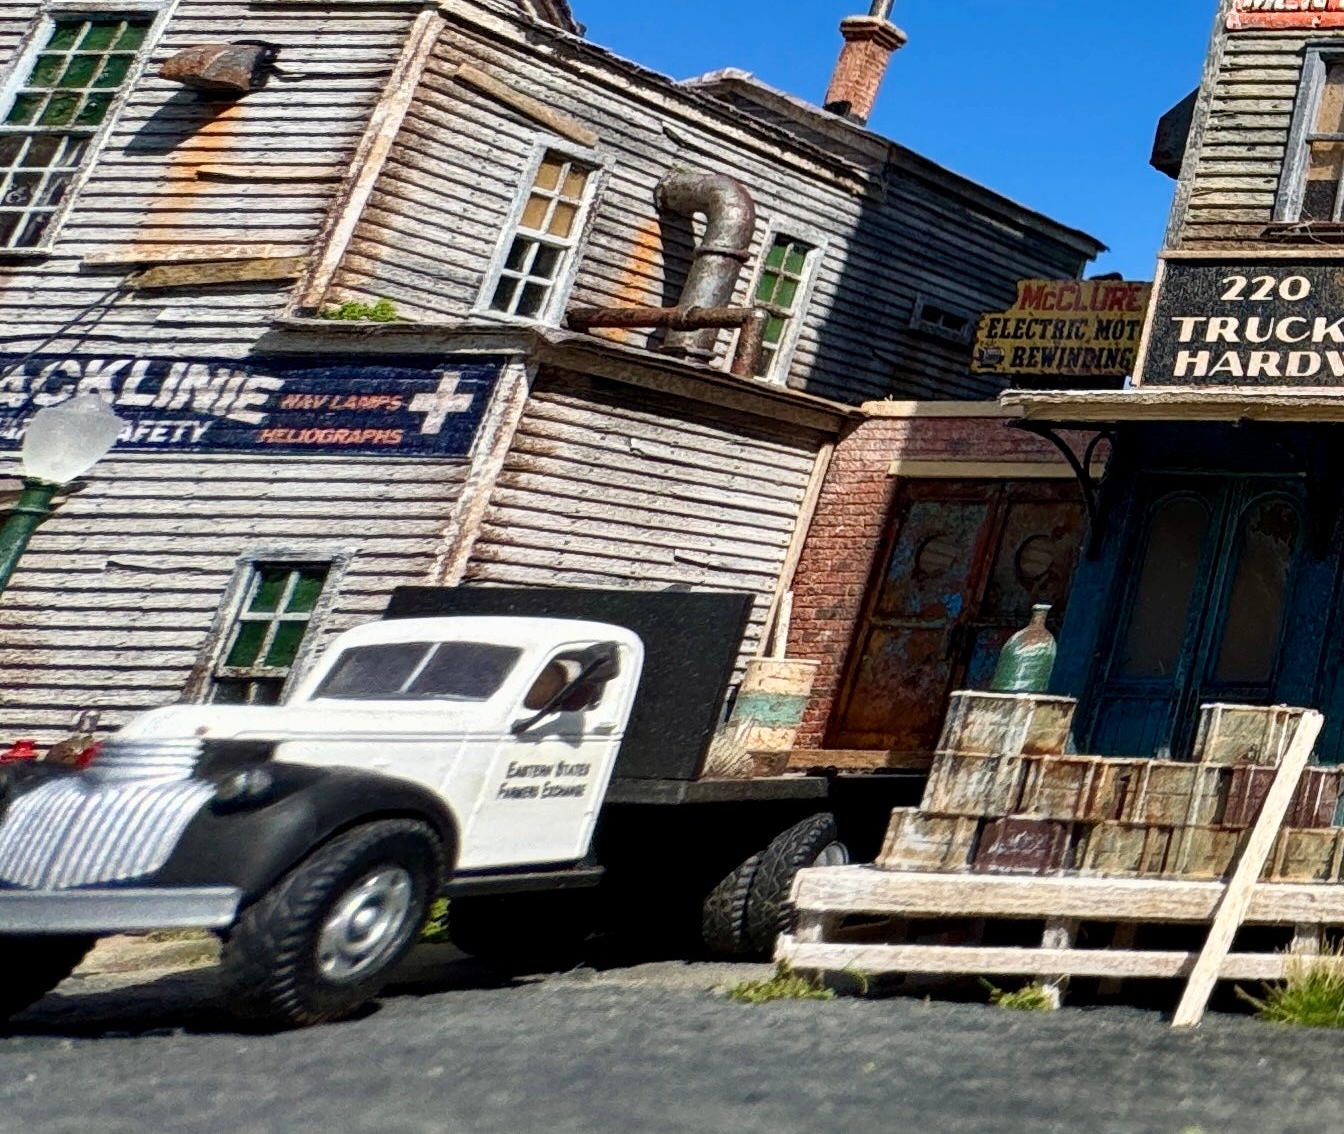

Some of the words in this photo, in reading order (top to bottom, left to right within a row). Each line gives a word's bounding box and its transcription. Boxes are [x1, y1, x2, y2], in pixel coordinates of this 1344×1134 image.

[1219, 275, 1311, 302] 220
[985, 317, 1089, 340] ELECTRIC
[1009, 346, 1134, 369] REWINDING
[256, 427, 404, 445] HELIOGRAPHS
